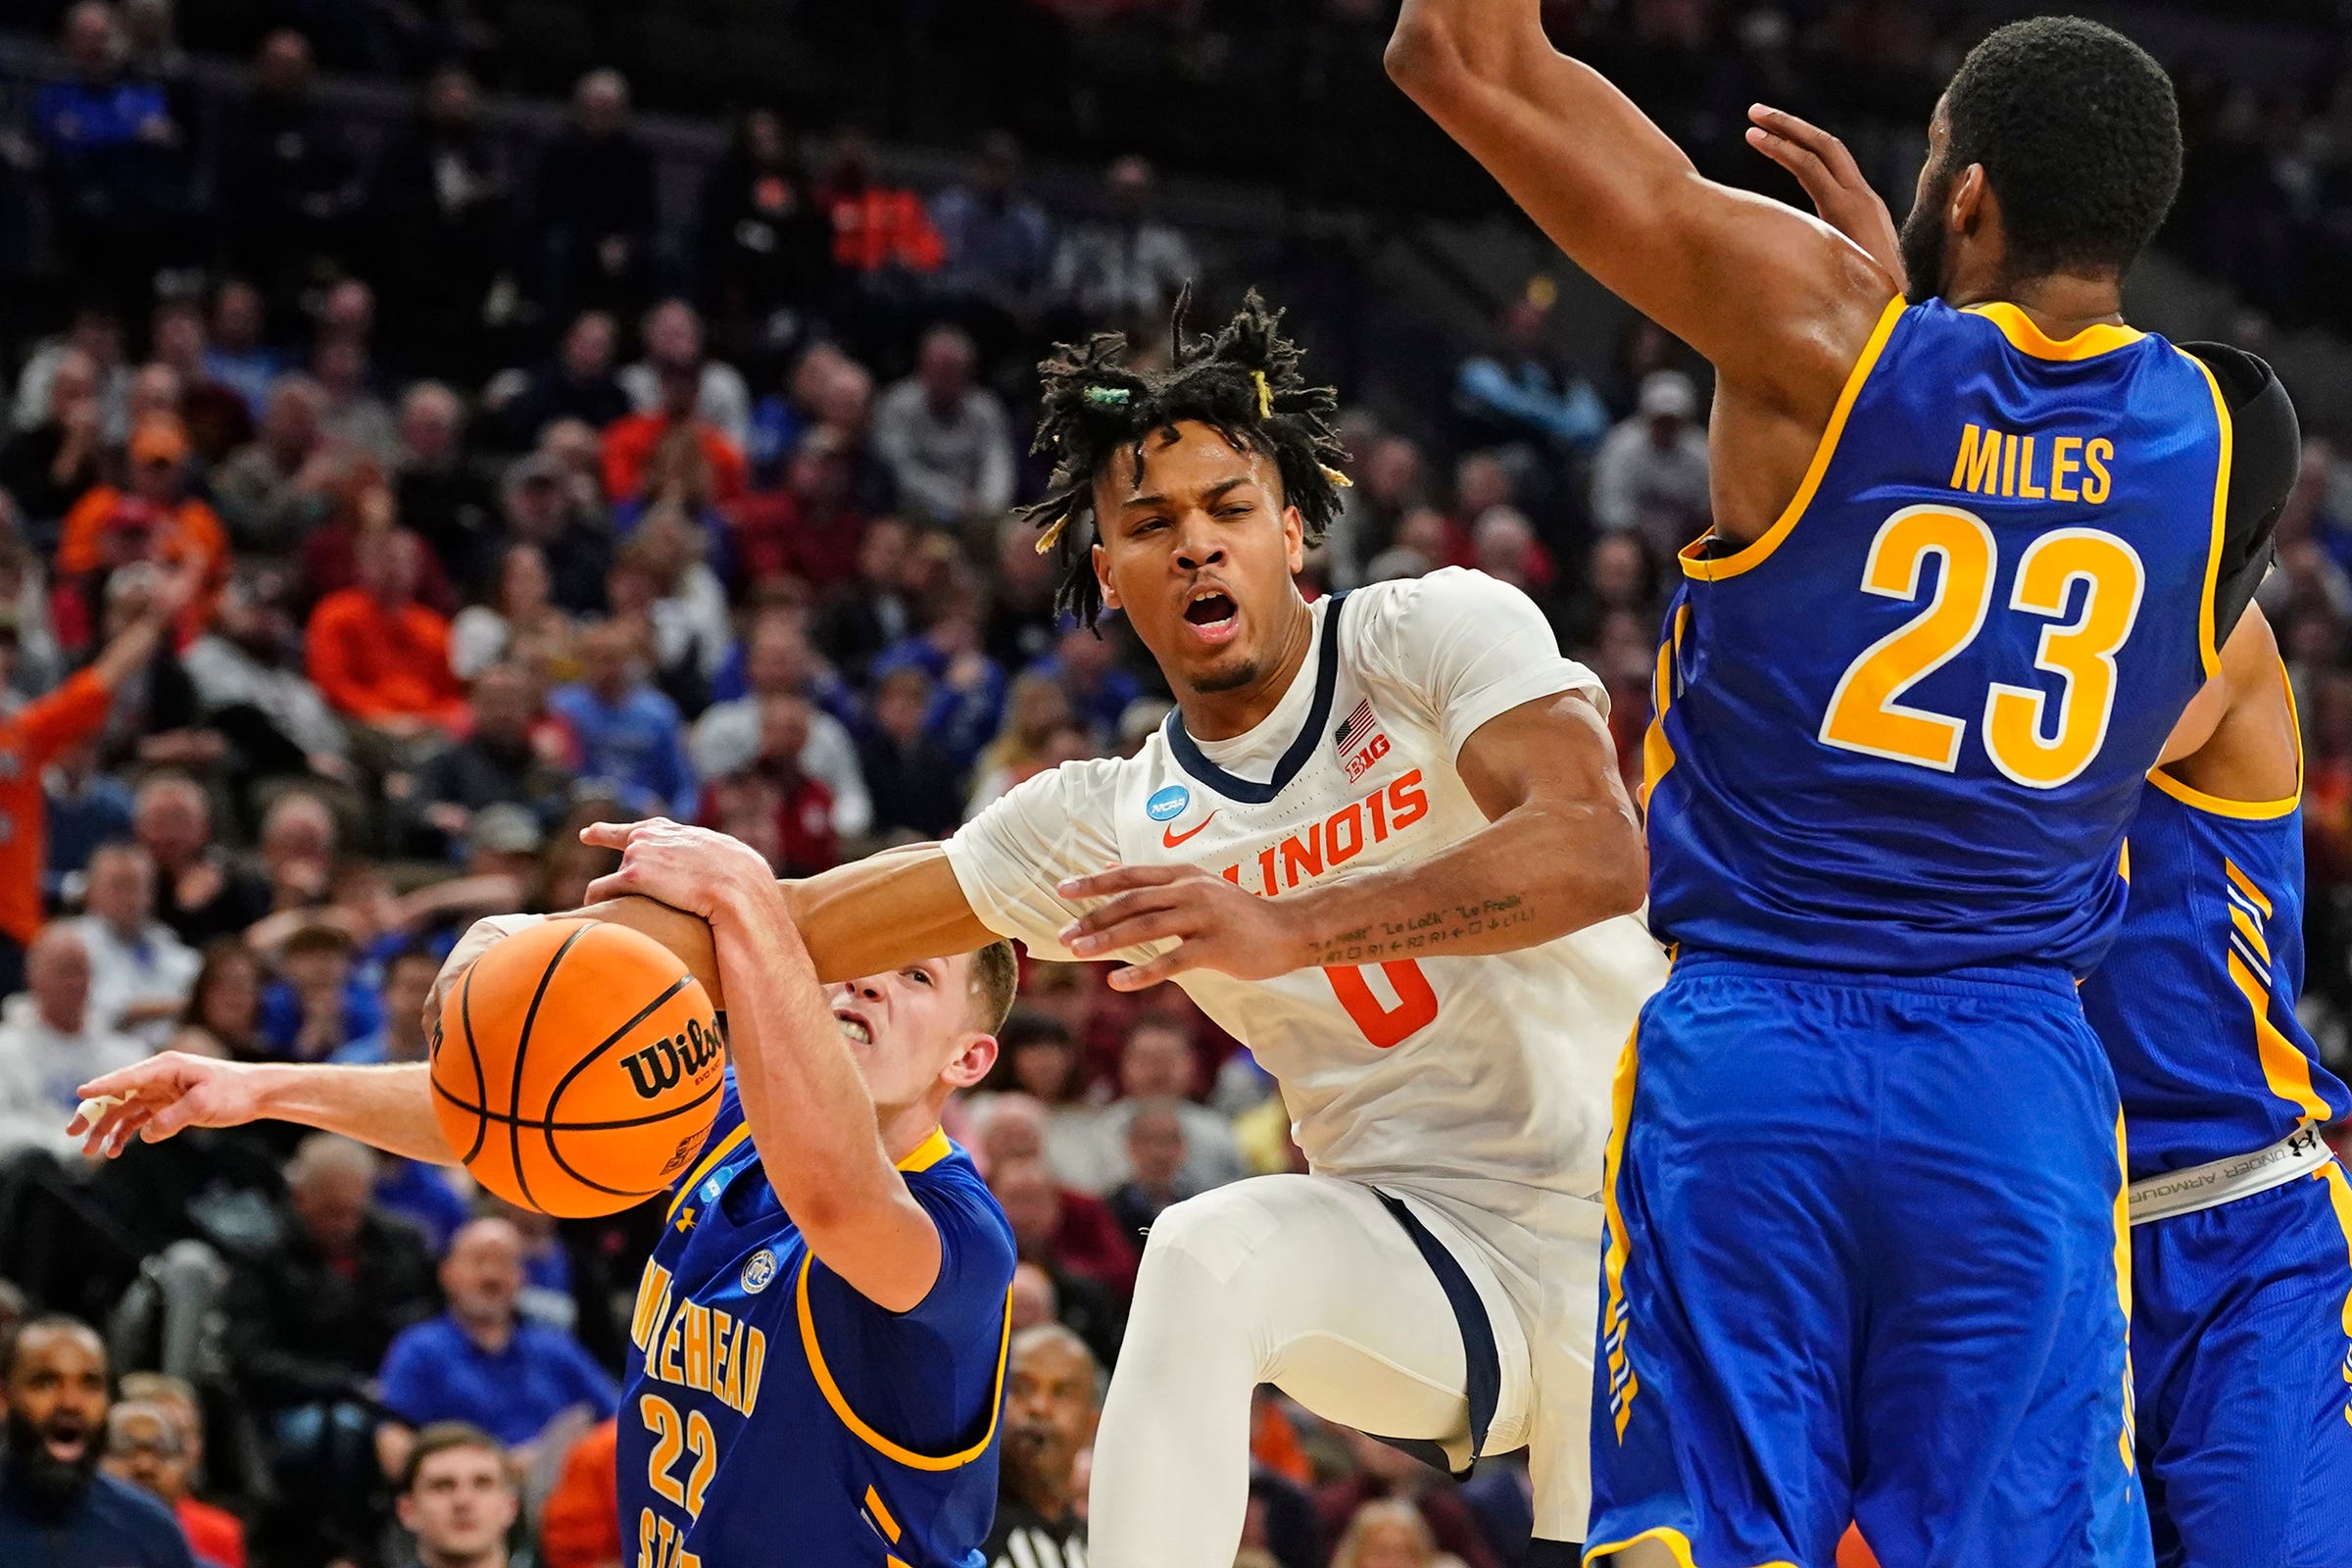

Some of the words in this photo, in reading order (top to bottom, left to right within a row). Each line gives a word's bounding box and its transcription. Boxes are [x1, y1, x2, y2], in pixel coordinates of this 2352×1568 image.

[1950, 423, 2114, 504] MILES
[1818, 504, 2145, 790] 23
[2224, 1148, 2286, 1179] UNDER
[639, 1394, 717, 1529] 22
